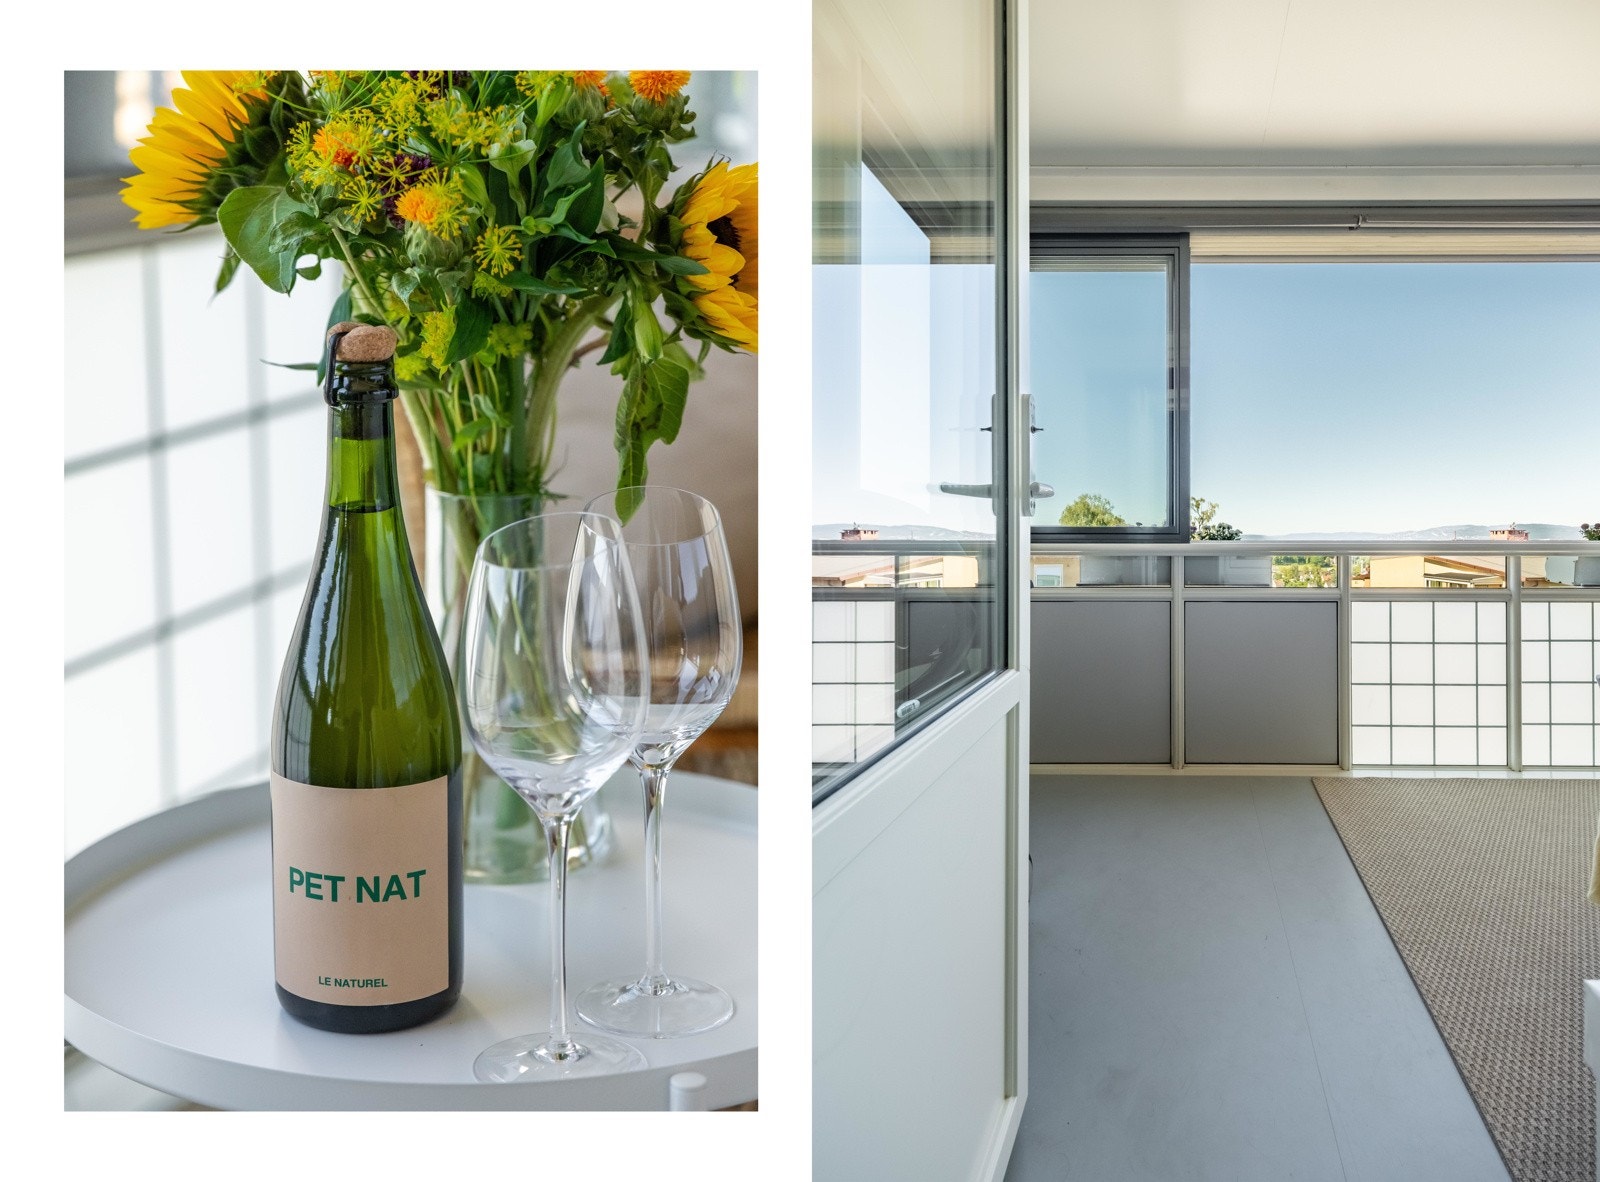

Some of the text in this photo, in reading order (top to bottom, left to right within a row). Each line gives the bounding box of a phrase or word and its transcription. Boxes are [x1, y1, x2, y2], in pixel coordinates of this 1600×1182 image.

[289, 866, 427, 903] PET NAT
[318, 976, 388, 989] LE NATUREL
